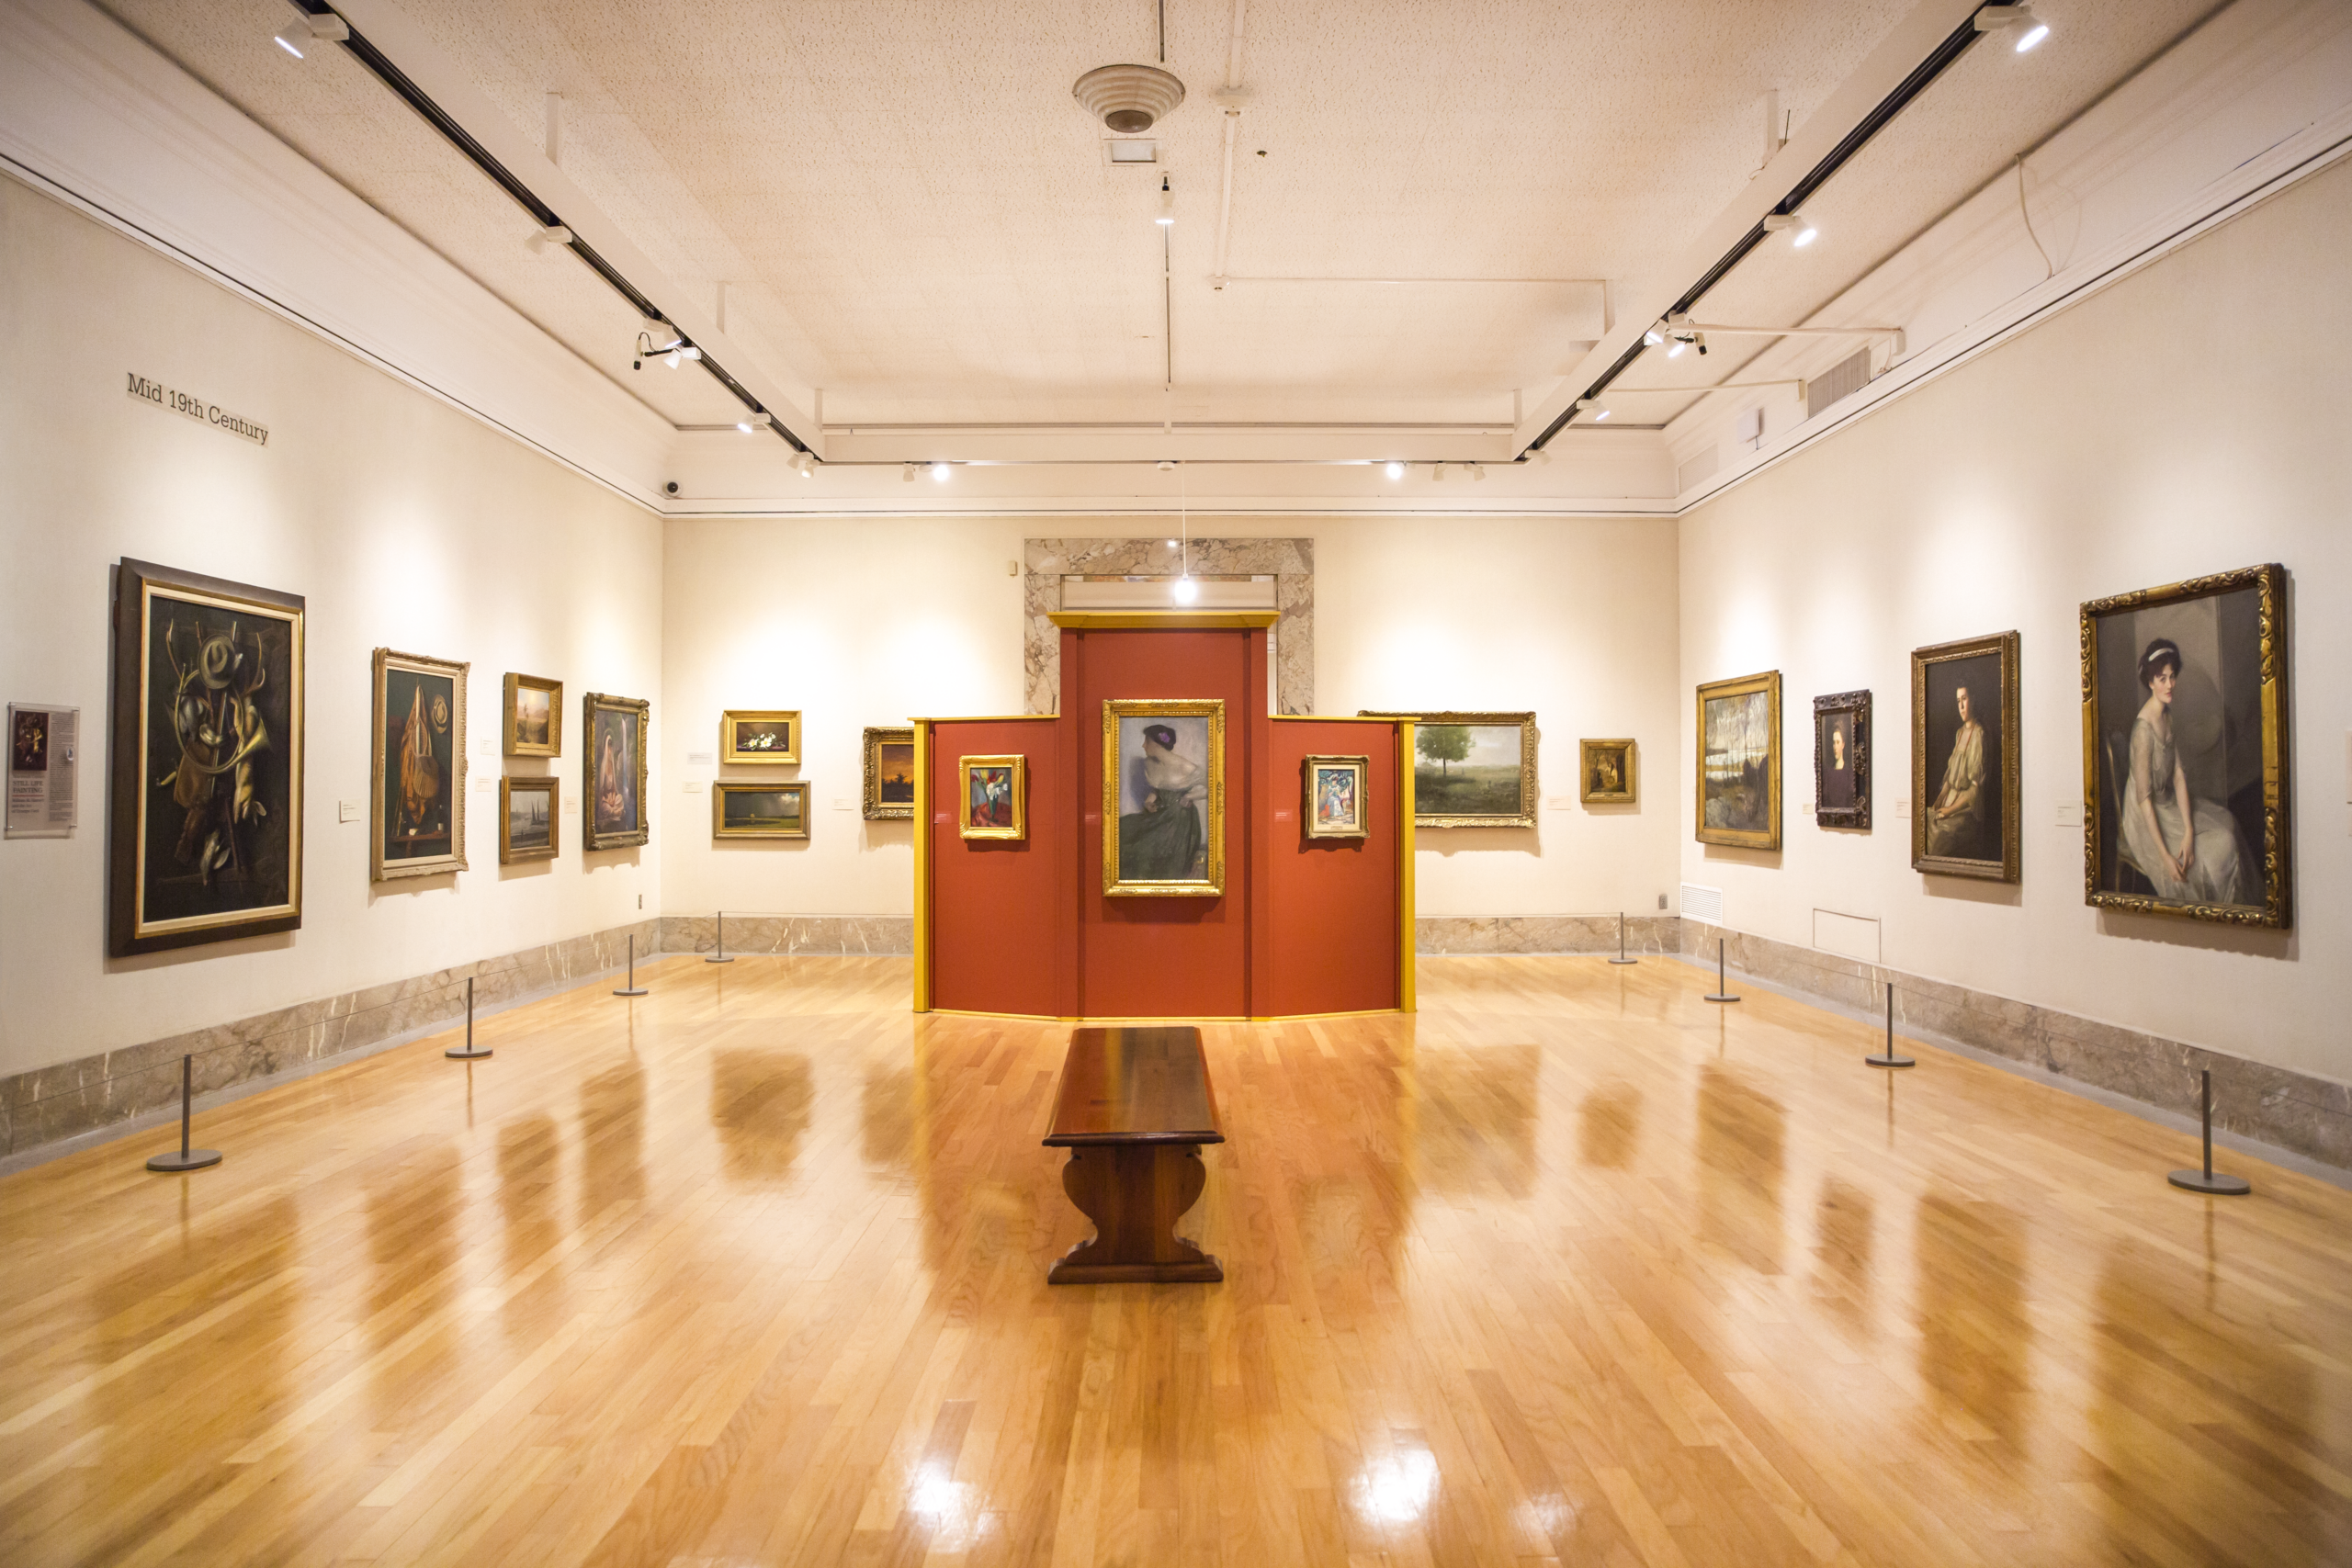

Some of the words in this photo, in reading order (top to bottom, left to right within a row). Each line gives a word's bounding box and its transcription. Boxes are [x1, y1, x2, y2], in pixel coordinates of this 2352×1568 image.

[128, 372, 163, 403] Mid
[169, 389, 204, 419] 19th
[209, 405, 268, 446] Century
